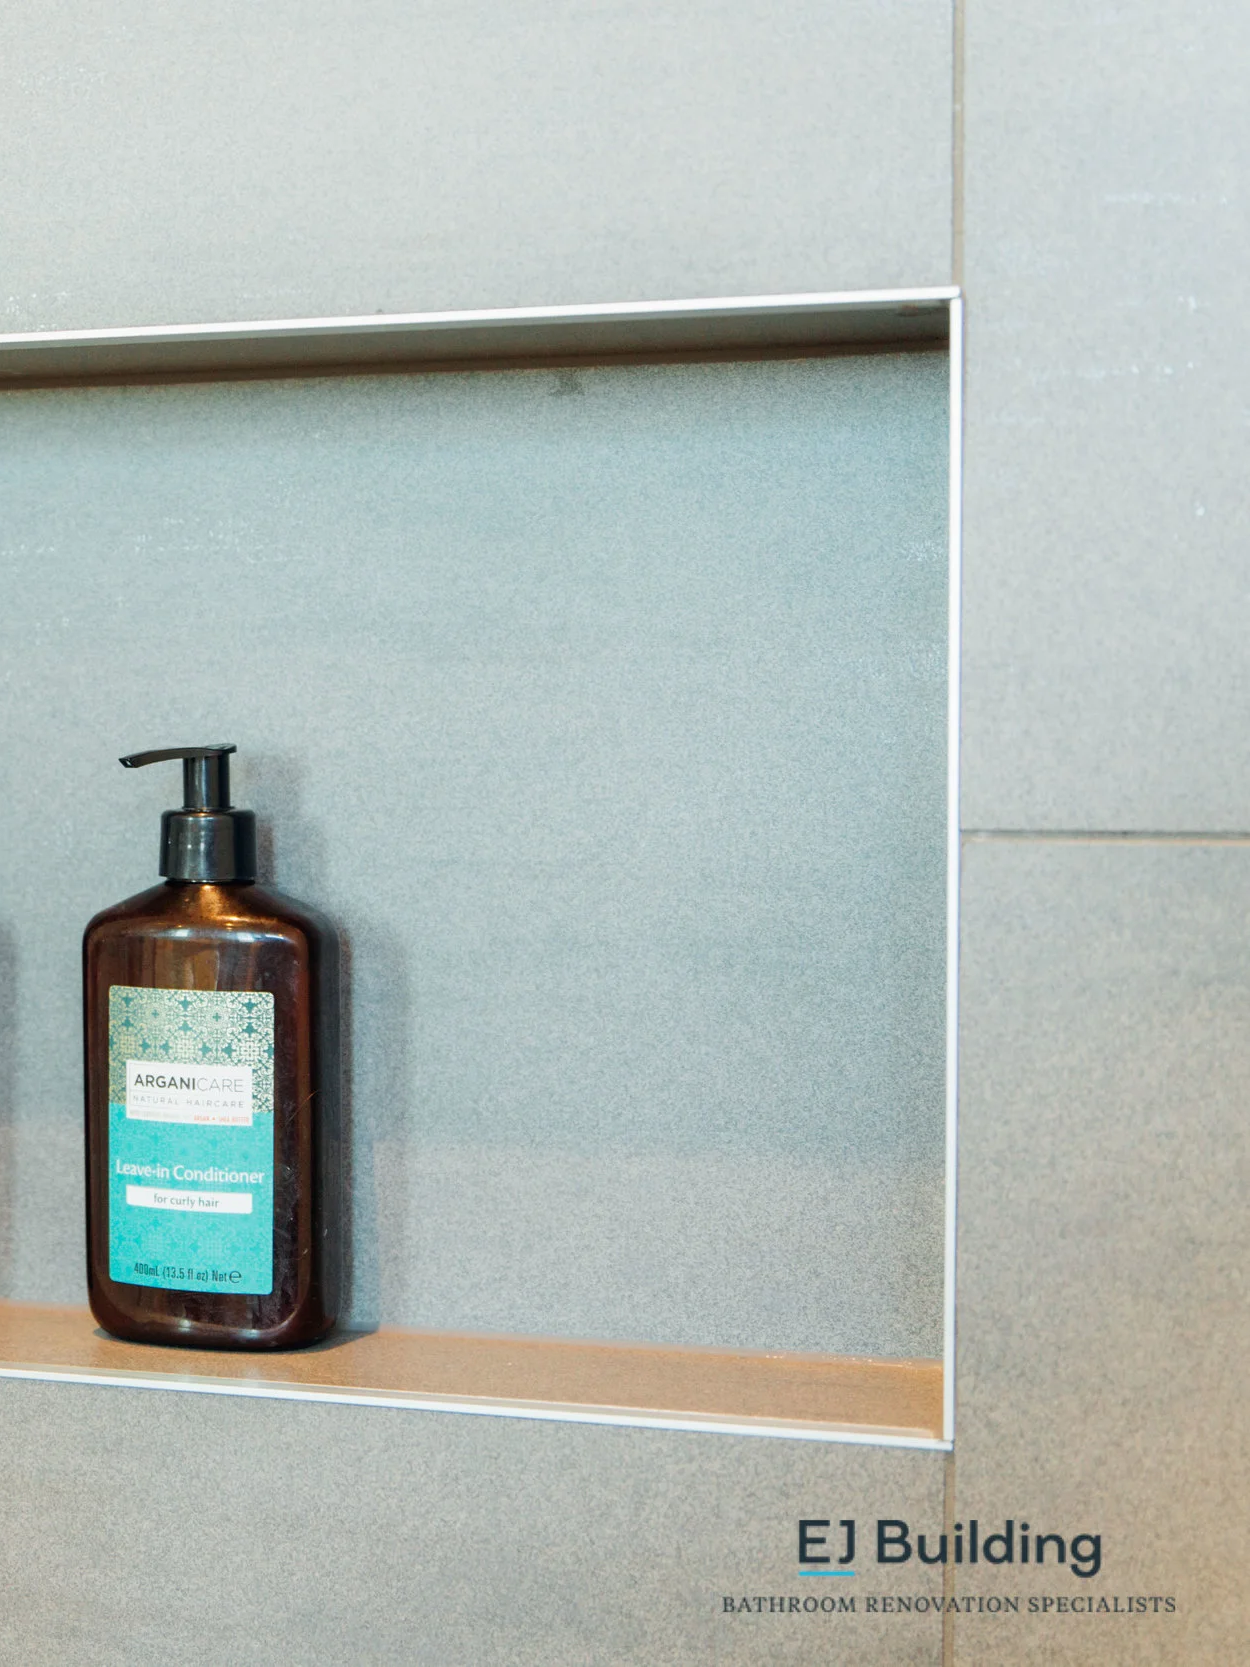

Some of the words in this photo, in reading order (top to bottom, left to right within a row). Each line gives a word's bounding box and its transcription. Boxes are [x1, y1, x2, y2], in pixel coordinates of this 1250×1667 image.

[133, 1073, 245, 1093] ARGANICARE
[132, 1094, 180, 1106] NATURAL
[186, 1099, 245, 1109] HAIRCARE
[115, 1159, 170, 1180] Leave-in
[172, 1164, 265, 1185] Conditioner
[153, 1193, 168, 1205] for
[170, 1194, 196, 1208] curly
[198, 1196, 219, 1209] hair
[133, 1262, 160, 1277] 400mL
[161, 1266, 185, 1281] (13.5
[196, 1269, 209, 1284] oz)
